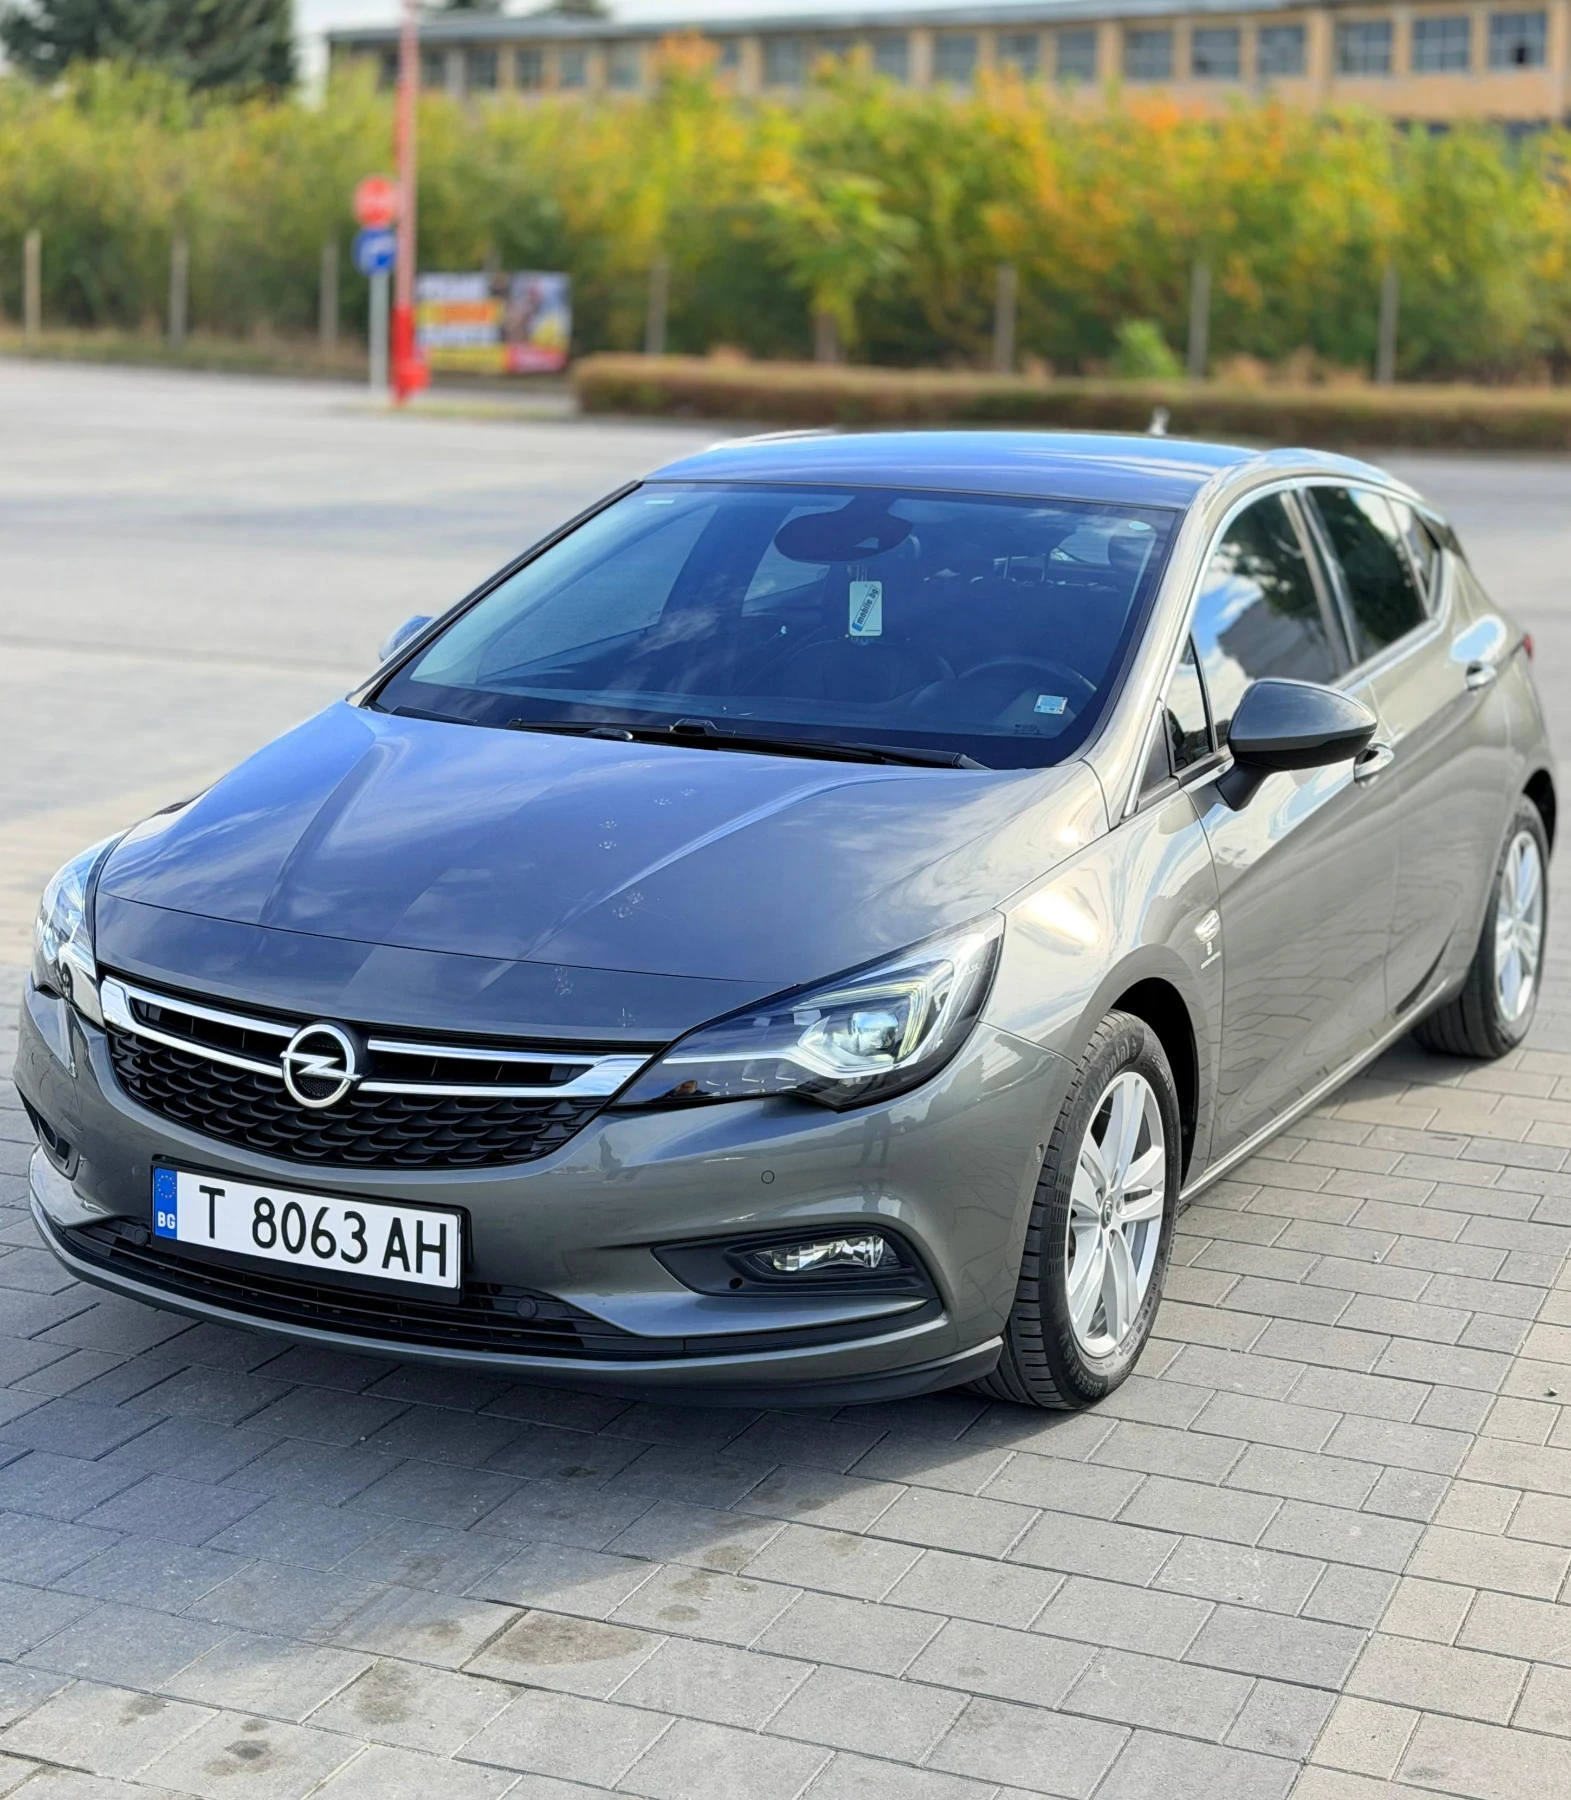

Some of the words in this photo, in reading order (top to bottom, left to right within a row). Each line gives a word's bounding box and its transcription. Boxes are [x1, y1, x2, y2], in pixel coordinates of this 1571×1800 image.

[157, 1211, 176, 1230] BG
[199, 1185, 226, 1239] T
[251, 1196, 369, 1264] 8063
[381, 1217, 448, 1277] AH
[1074, 1369, 1104, 1397] 205/55
